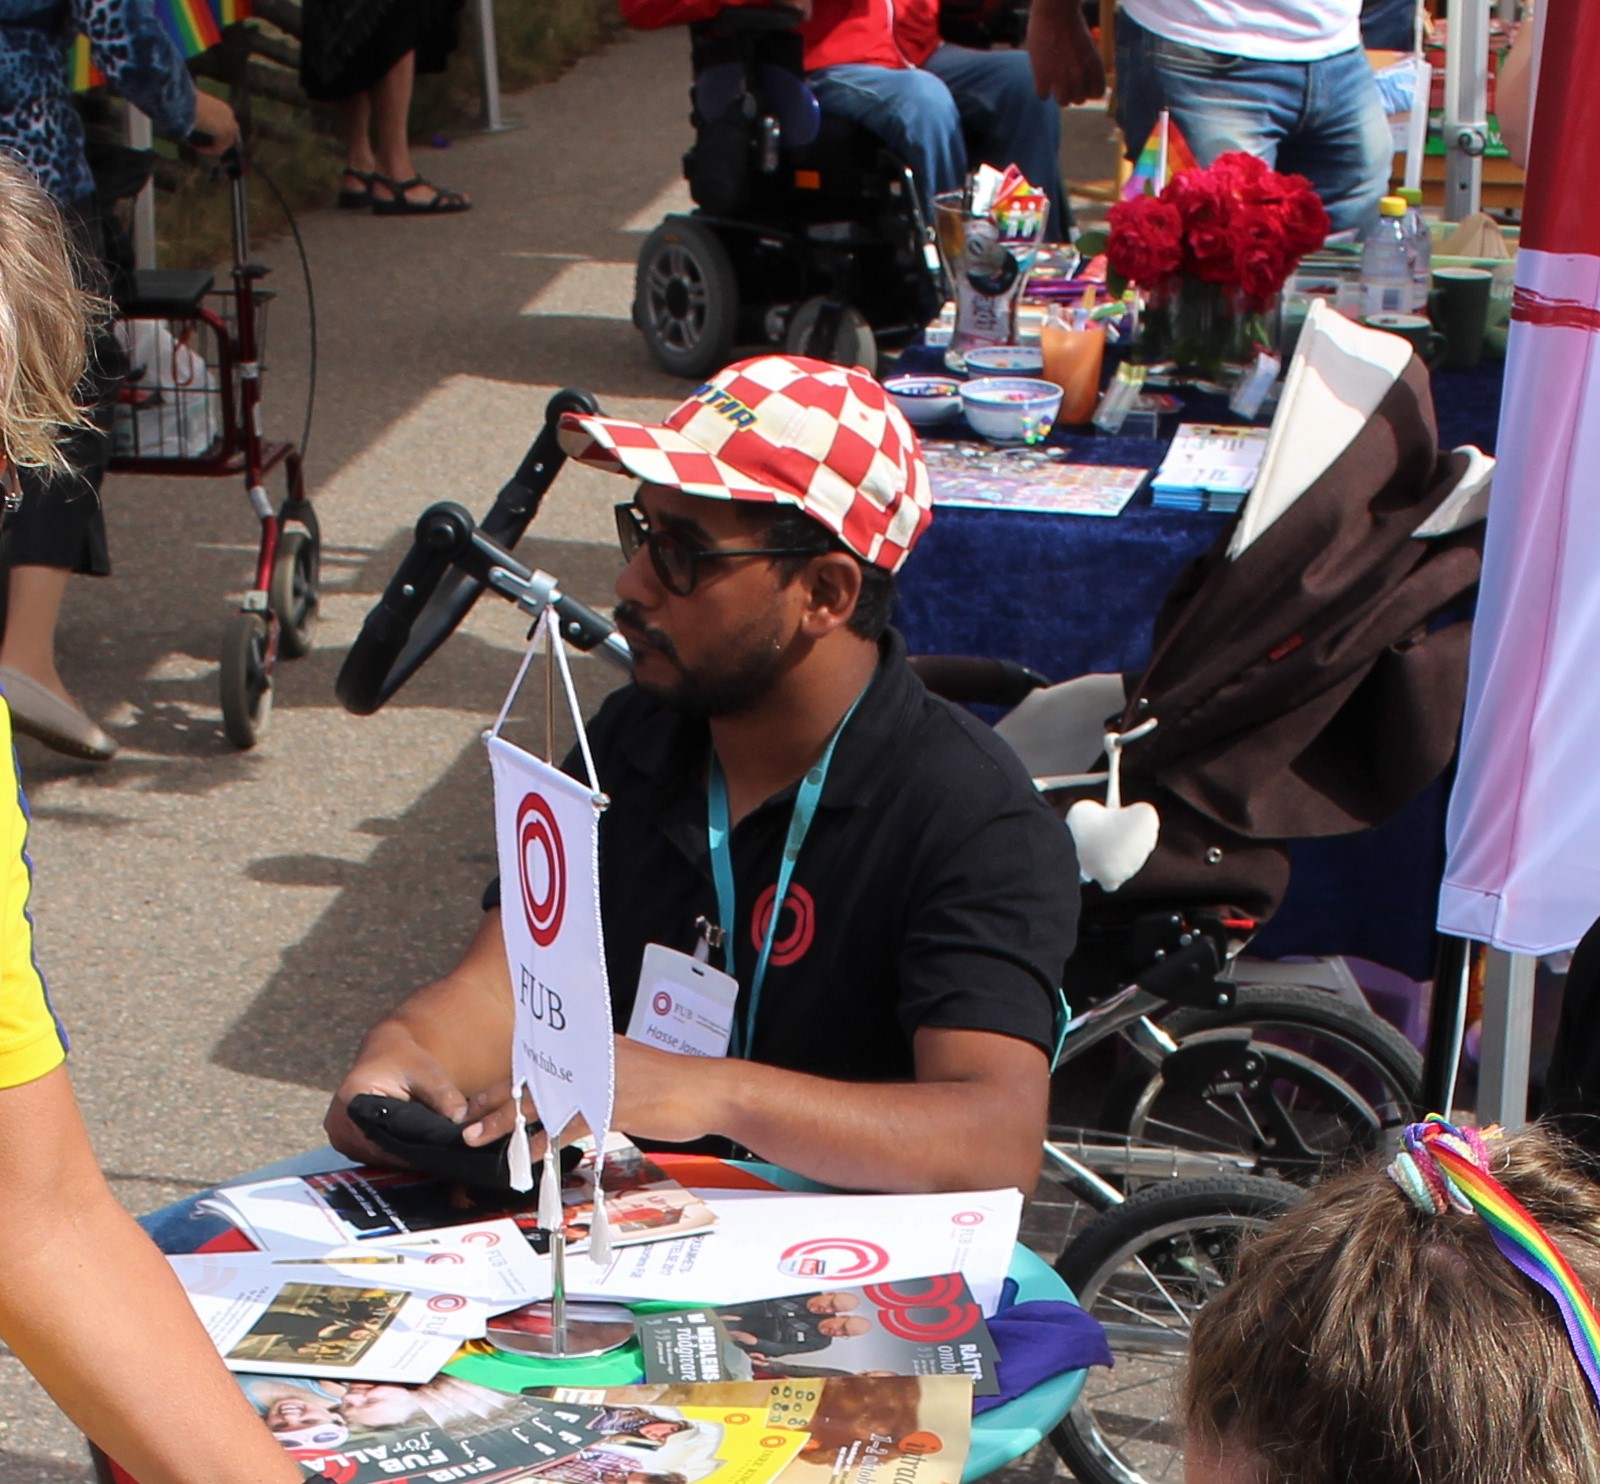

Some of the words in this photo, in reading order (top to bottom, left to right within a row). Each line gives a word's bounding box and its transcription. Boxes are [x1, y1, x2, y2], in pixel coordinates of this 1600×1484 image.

[519, 962, 568, 1031] FUB
[646, 1023, 679, 1048] Hasse
[674, 1327, 699, 1382] rådgivare
[697, 1325, 721, 1384] MEDLEMS-
[393, 1430, 433, 1453] för
[299, 1443, 389, 1474] ALLA
[378, 1447, 450, 1474] FUB
